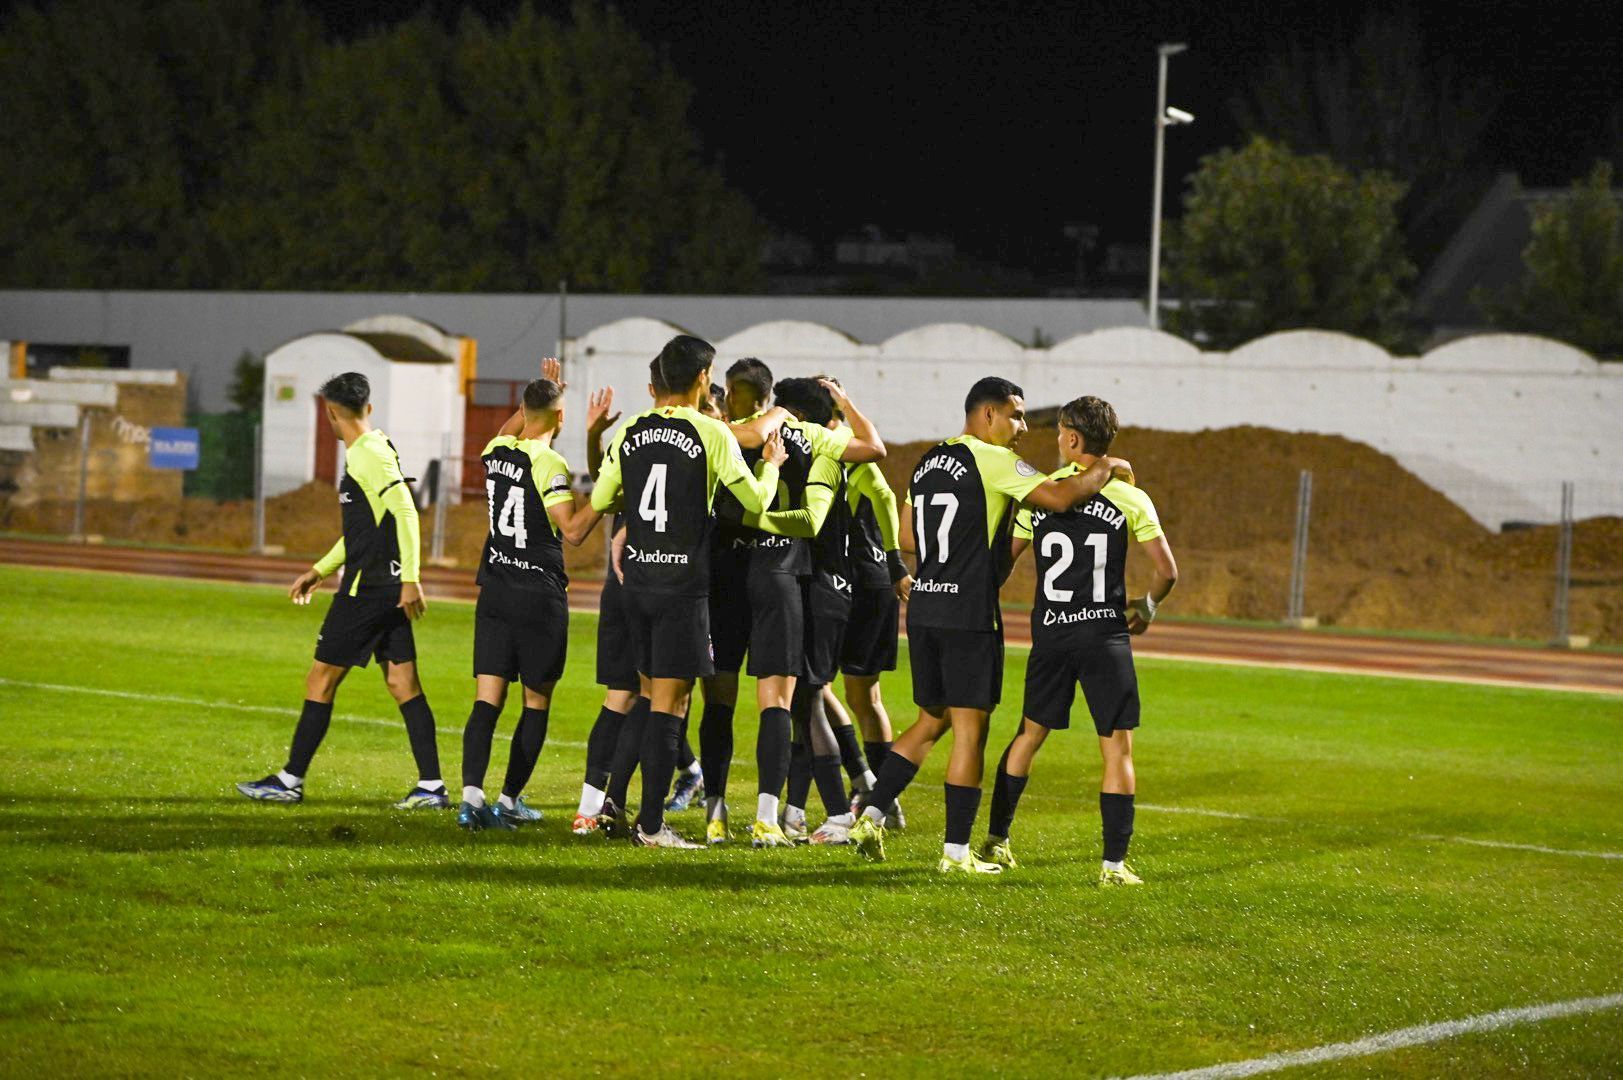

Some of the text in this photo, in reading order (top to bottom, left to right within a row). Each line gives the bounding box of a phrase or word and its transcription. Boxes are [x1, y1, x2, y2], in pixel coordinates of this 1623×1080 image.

[638, 463, 668, 533] 4
[913, 454, 968, 484] CLEMENTE
[486, 478, 527, 549] 14
[913, 493, 960, 564] 17
[636, 549, 689, 564] Andorra
[1041, 531, 1108, 603] 21
[1057, 607, 1117, 624] Andorra
